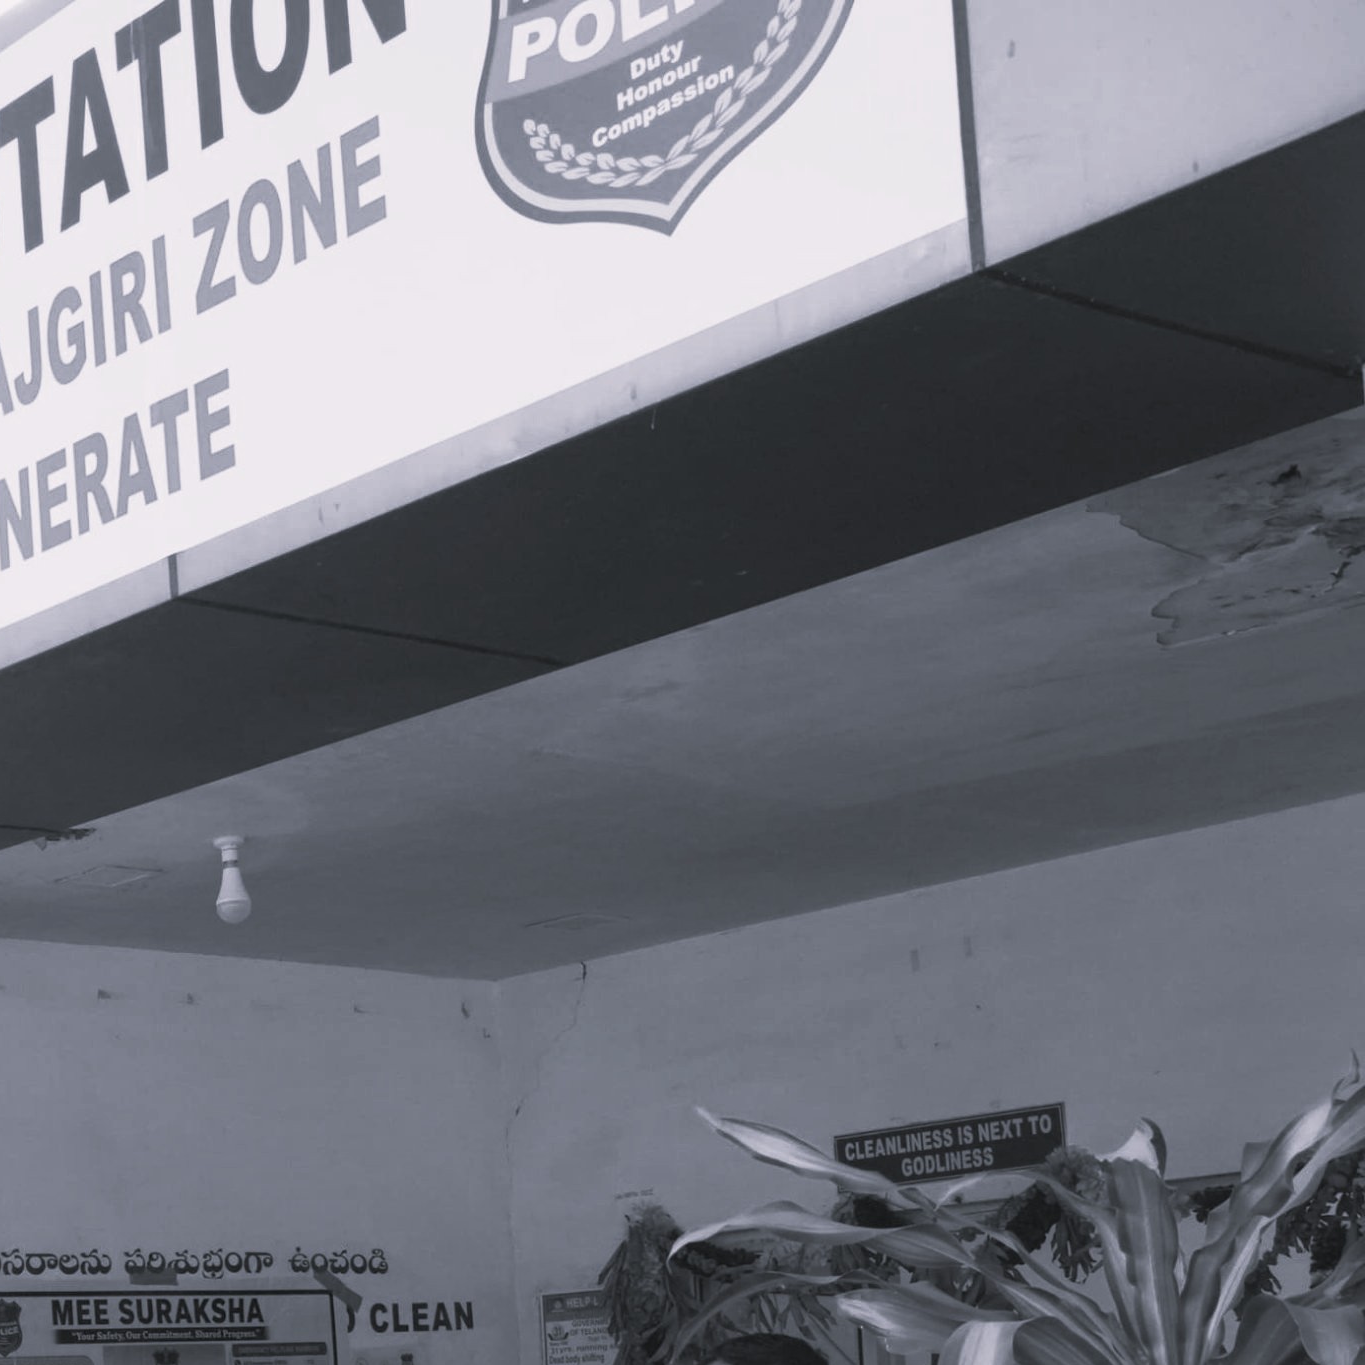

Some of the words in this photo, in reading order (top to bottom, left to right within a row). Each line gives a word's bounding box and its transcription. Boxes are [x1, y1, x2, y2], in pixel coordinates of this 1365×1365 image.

[508, 0, 696, 83] POL
[629, 41, 685, 80] Duty
[617, 56, 701, 111] Honour
[592, 65, 734, 147] Compassion
[193, 115, 387, 315] ZONE
[844, 1129, 953, 1161] CLEANLINESS
[957, 1125, 974, 1145] IS
[977, 1118, 1024, 1143] NEXT
[1027, 1113, 1052, 1135] TO
[901, 1146, 994, 1177] GODLINESS
[124, 1248, 274, 1280] పరిశుభ్రంగా
[287, 1247, 389, 1275] ఉంచండి
[51, 1299, 110, 1326] MEE
[118, 1298, 265, 1325] SURAKSHA
[369, 1302, 474, 1333] CLEAN
[566, 1296, 591, 1309] HELP
[125, 1331, 142, 1341] Our
[195, 1329, 221, 1340] Shared
